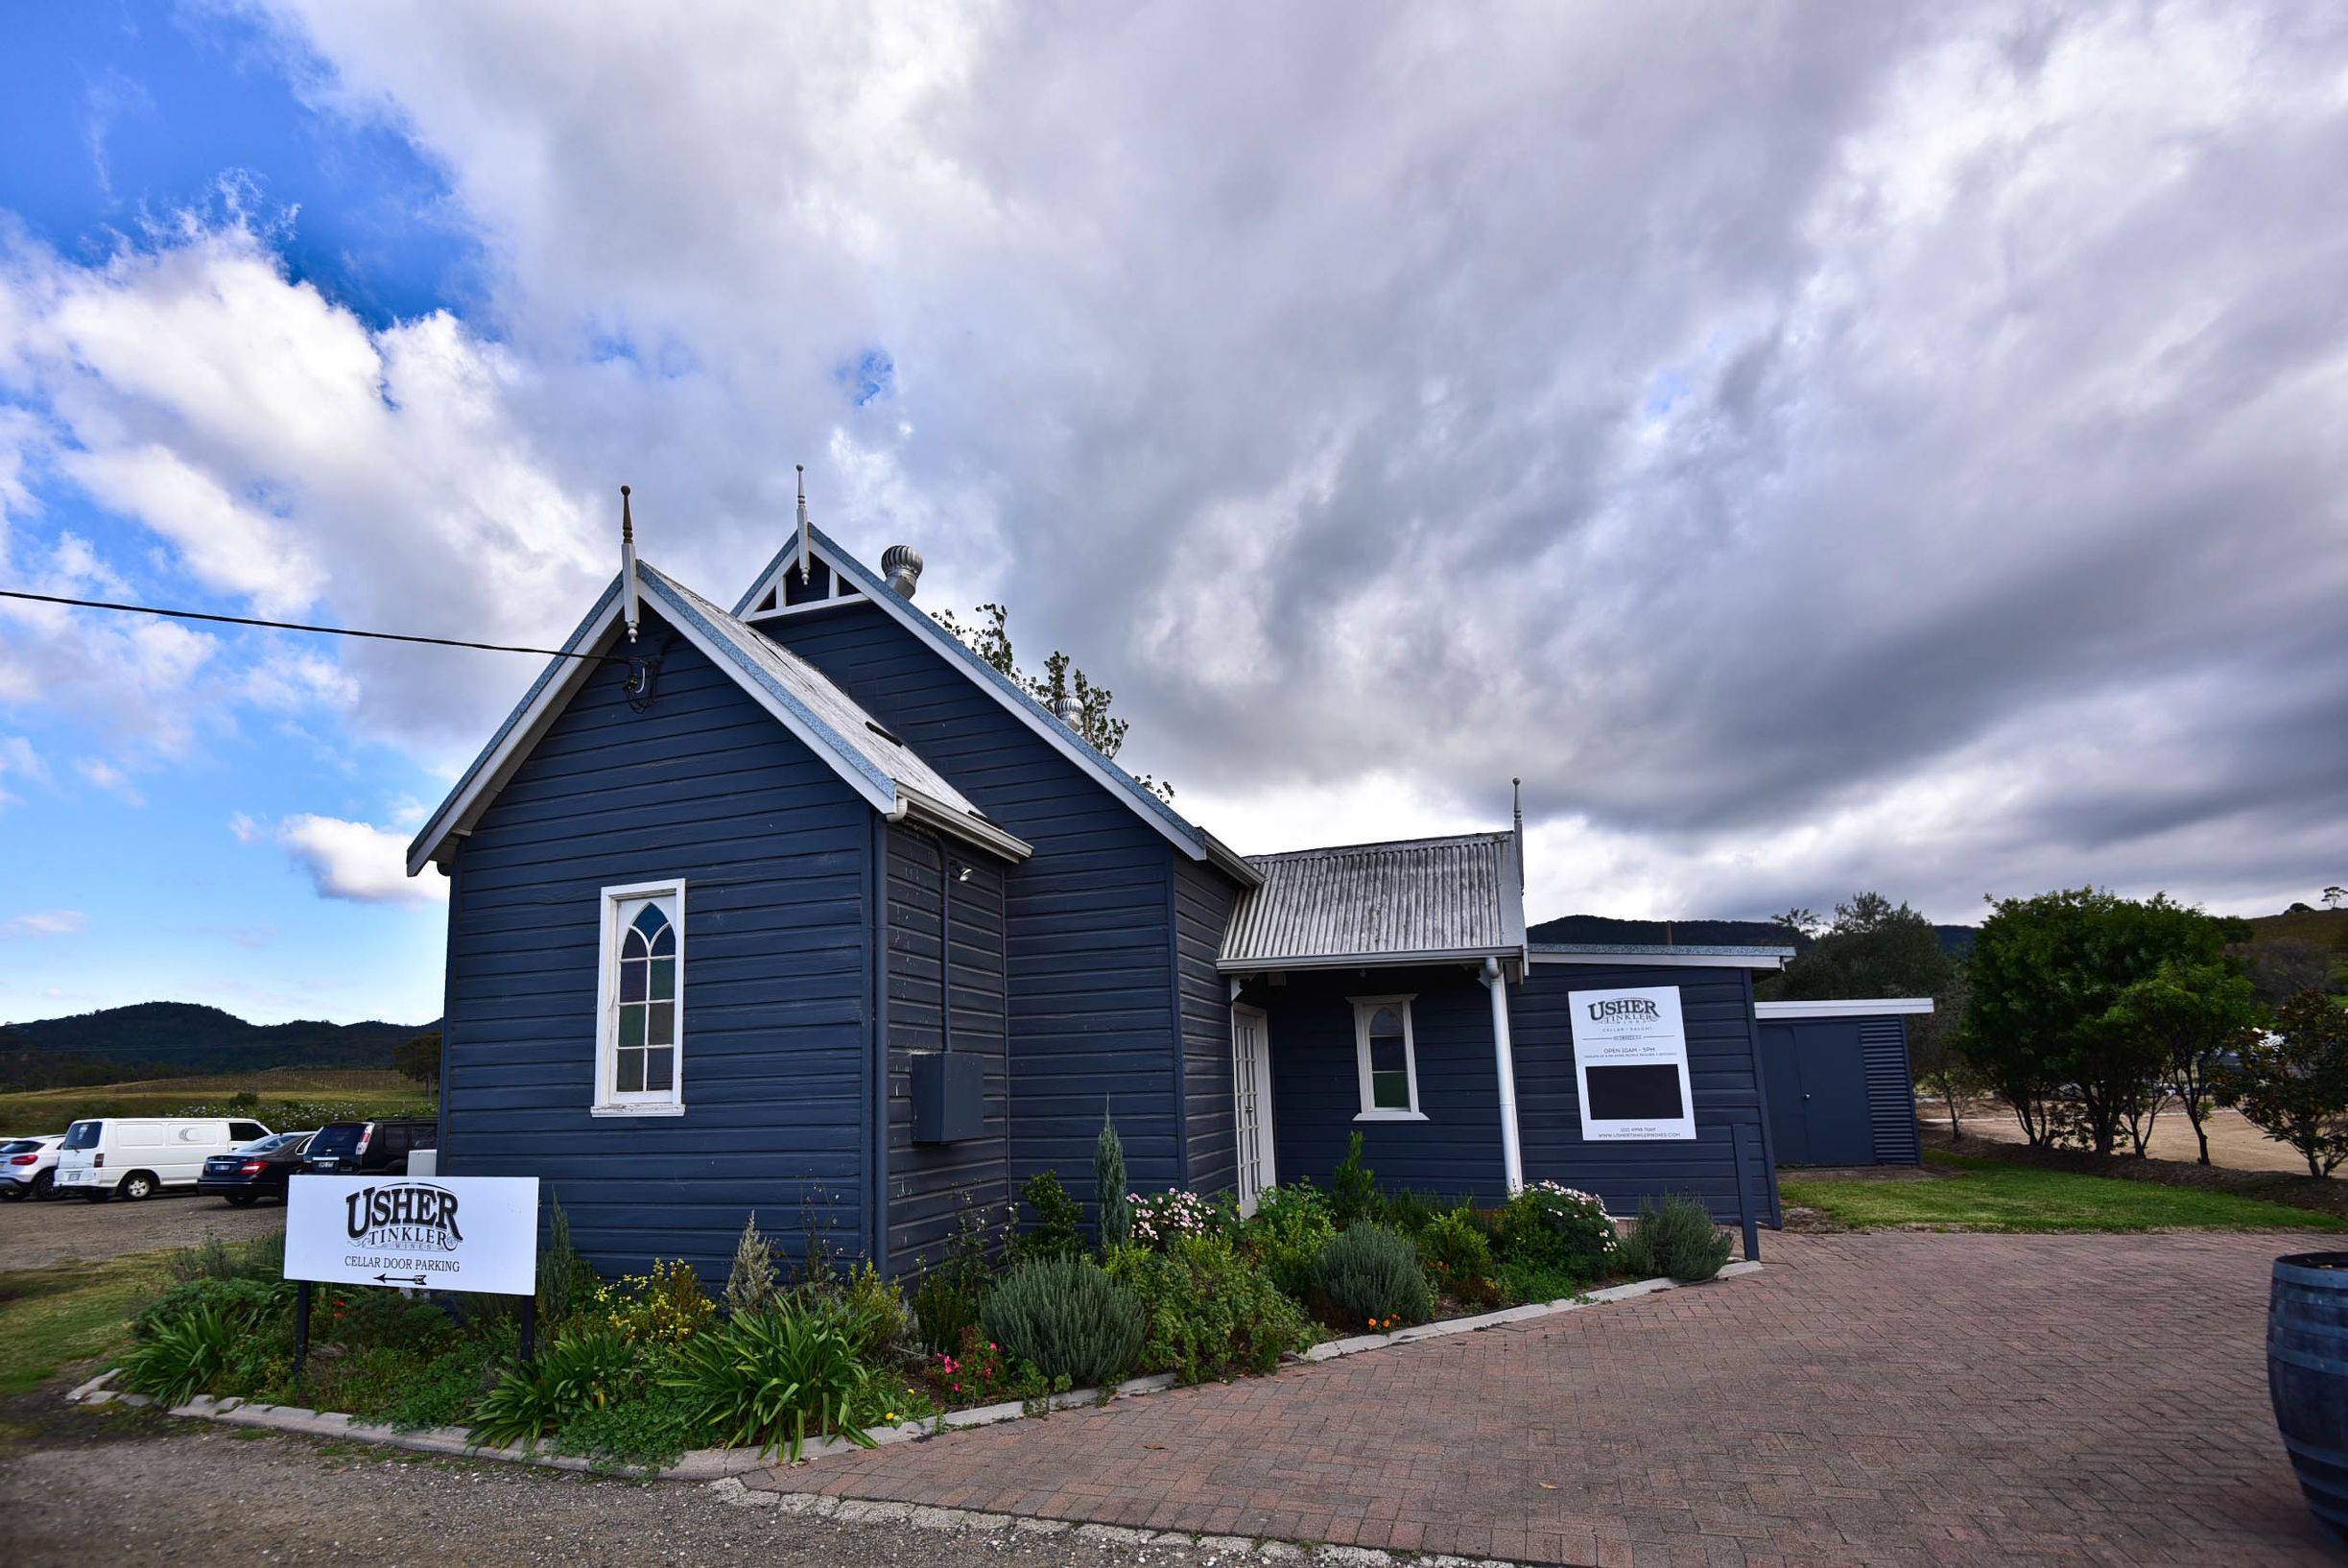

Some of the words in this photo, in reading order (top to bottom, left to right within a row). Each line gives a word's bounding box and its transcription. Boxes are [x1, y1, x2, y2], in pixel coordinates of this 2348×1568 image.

[1587, 1000, 1661, 1021] USHER
[1604, 1013, 1651, 1023] TINKLER
[346, 1187, 462, 1241] USHER
[368, 1227, 451, 1247] TINKLER
[344, 1255, 381, 1269] CELLAR
[384, 1257, 413, 1270] DOOR
[415, 1259, 461, 1272] PARKING
